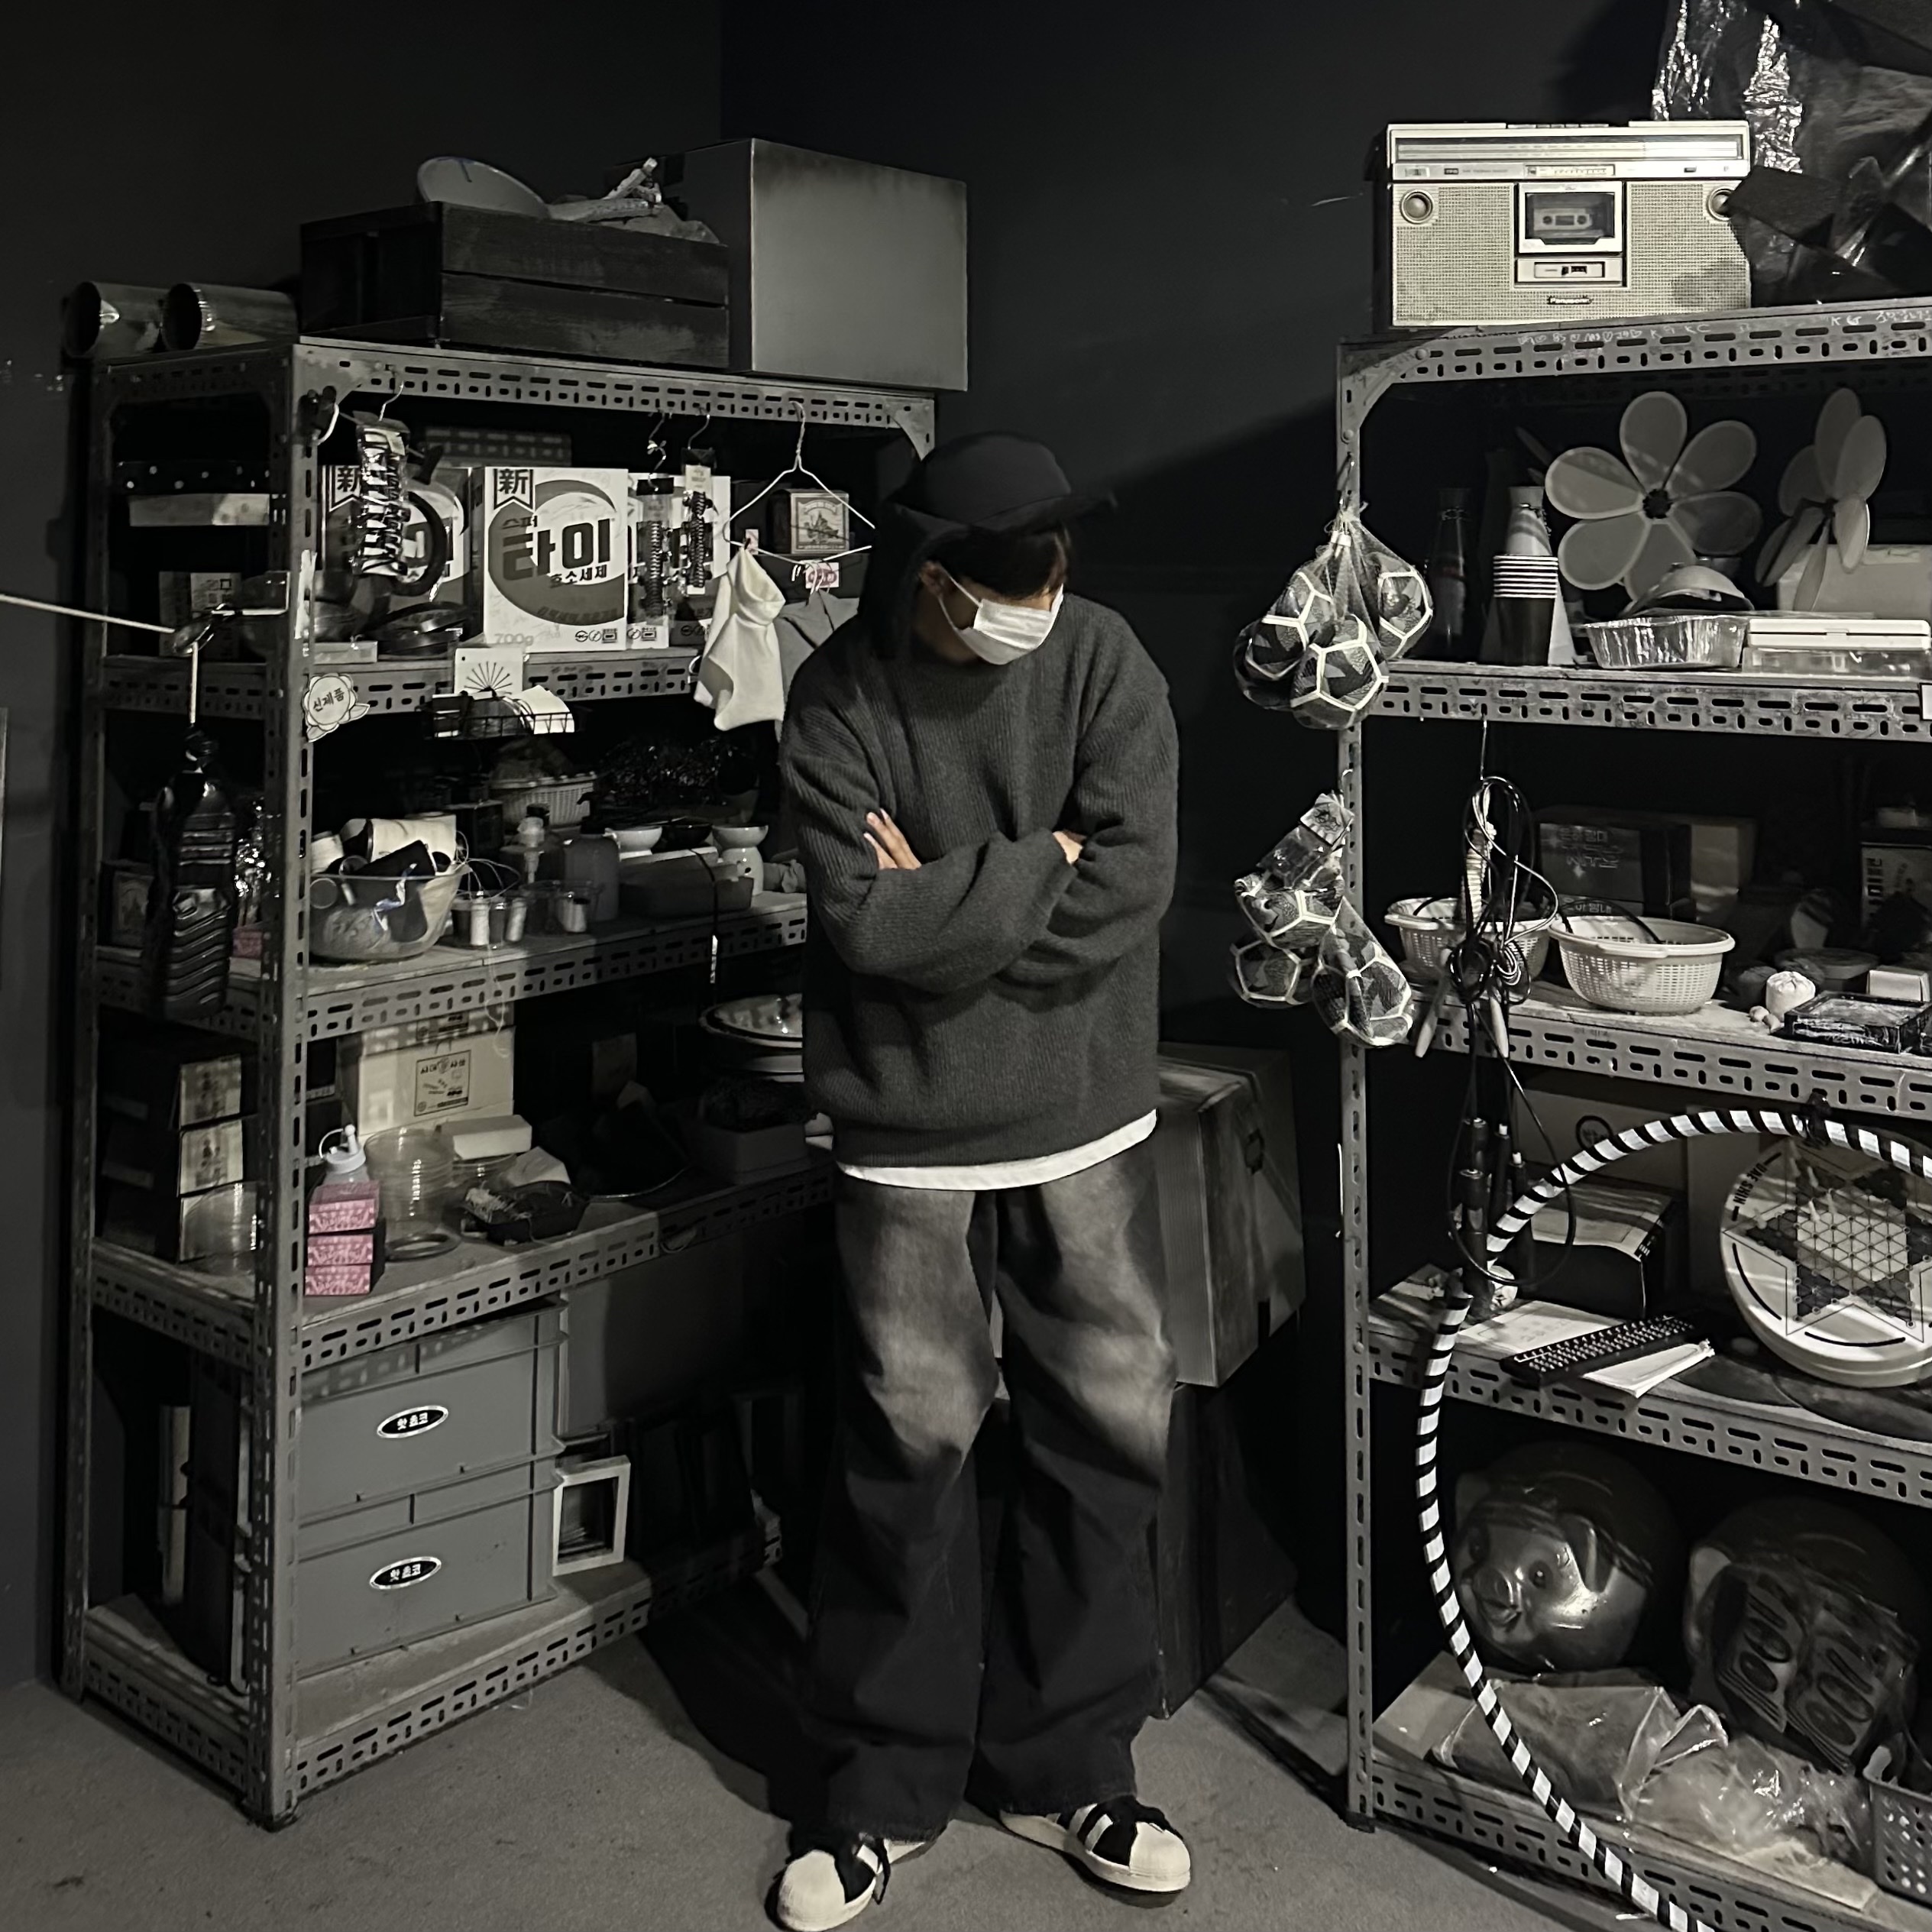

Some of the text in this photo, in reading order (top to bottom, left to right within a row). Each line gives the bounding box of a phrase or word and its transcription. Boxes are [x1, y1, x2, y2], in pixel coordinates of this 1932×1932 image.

[499, 468, 529, 494] 新
[503, 518, 610, 581] 타이
[494, 633, 534, 646] 700g
[312, 687, 345, 712] 신제품
[1733, 1163, 1768, 1205] DAE SHIN
